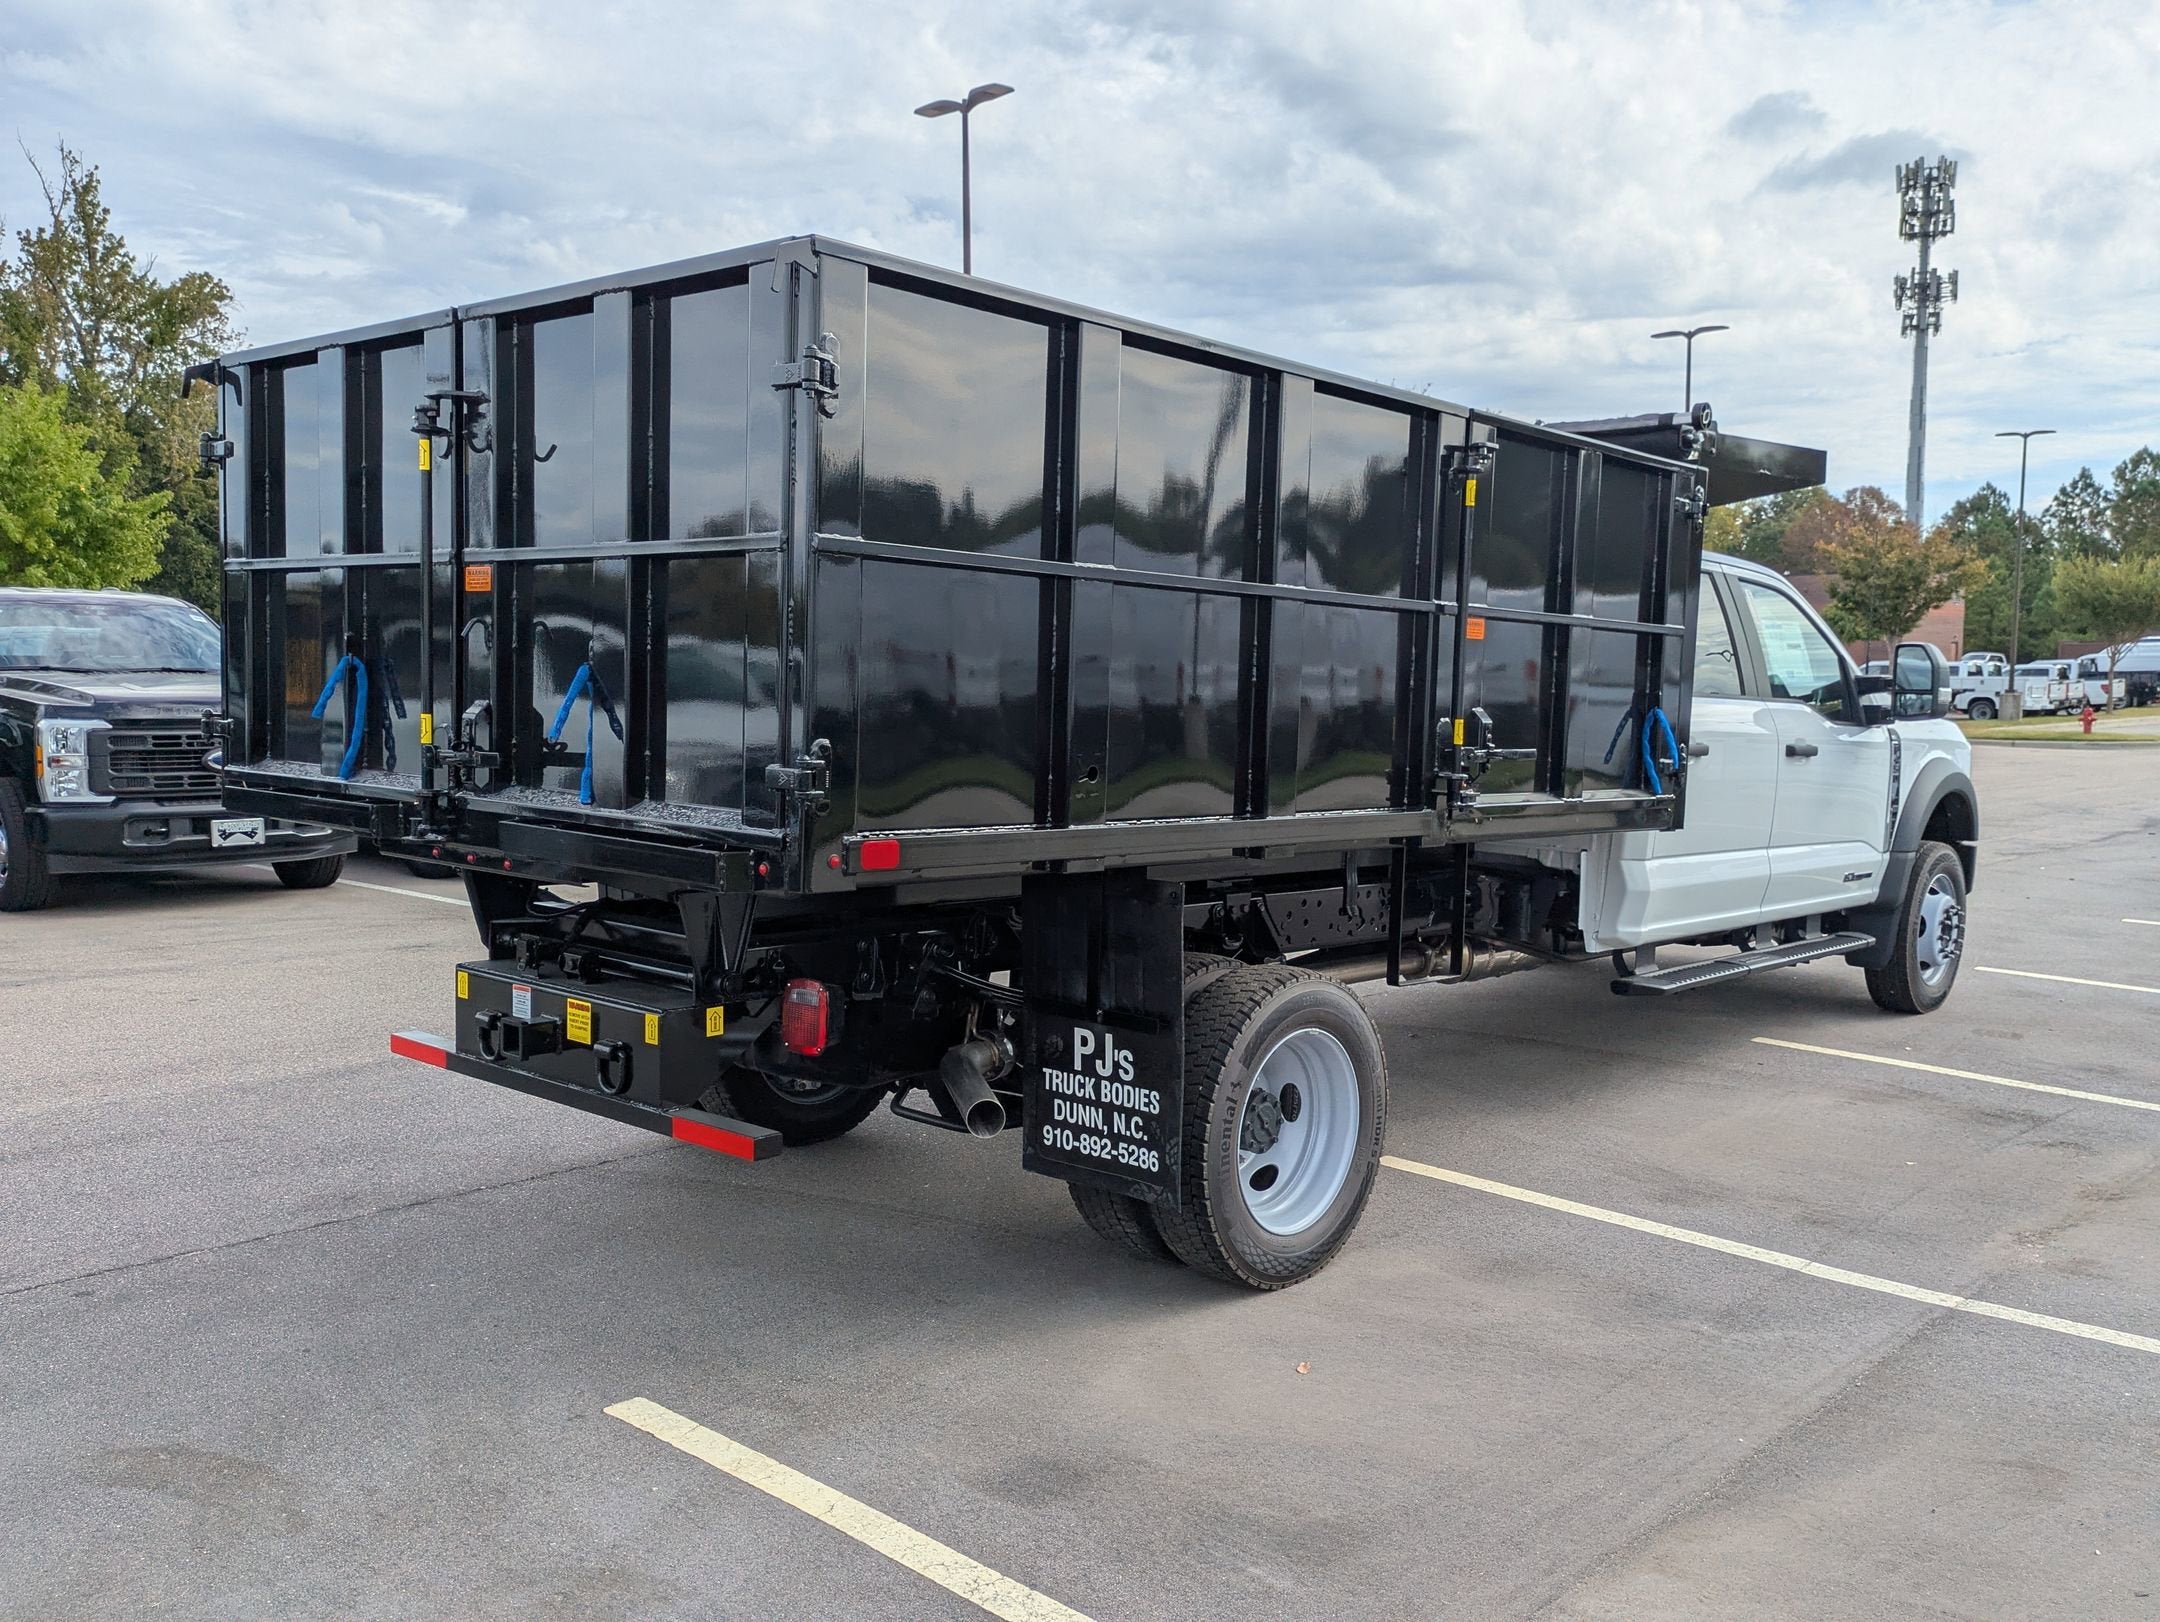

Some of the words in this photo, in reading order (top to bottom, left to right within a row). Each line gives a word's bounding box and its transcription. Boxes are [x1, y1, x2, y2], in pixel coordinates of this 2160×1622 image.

[1042, 1068, 1096, 1101] TRUCK
[1101, 1080, 1160, 1115] BODIES
[1053, 1098, 1108, 1135] DUNN,
[1113, 1112, 1148, 1141] N.C.
[1042, 1125, 1160, 1172] 910-892-5286
